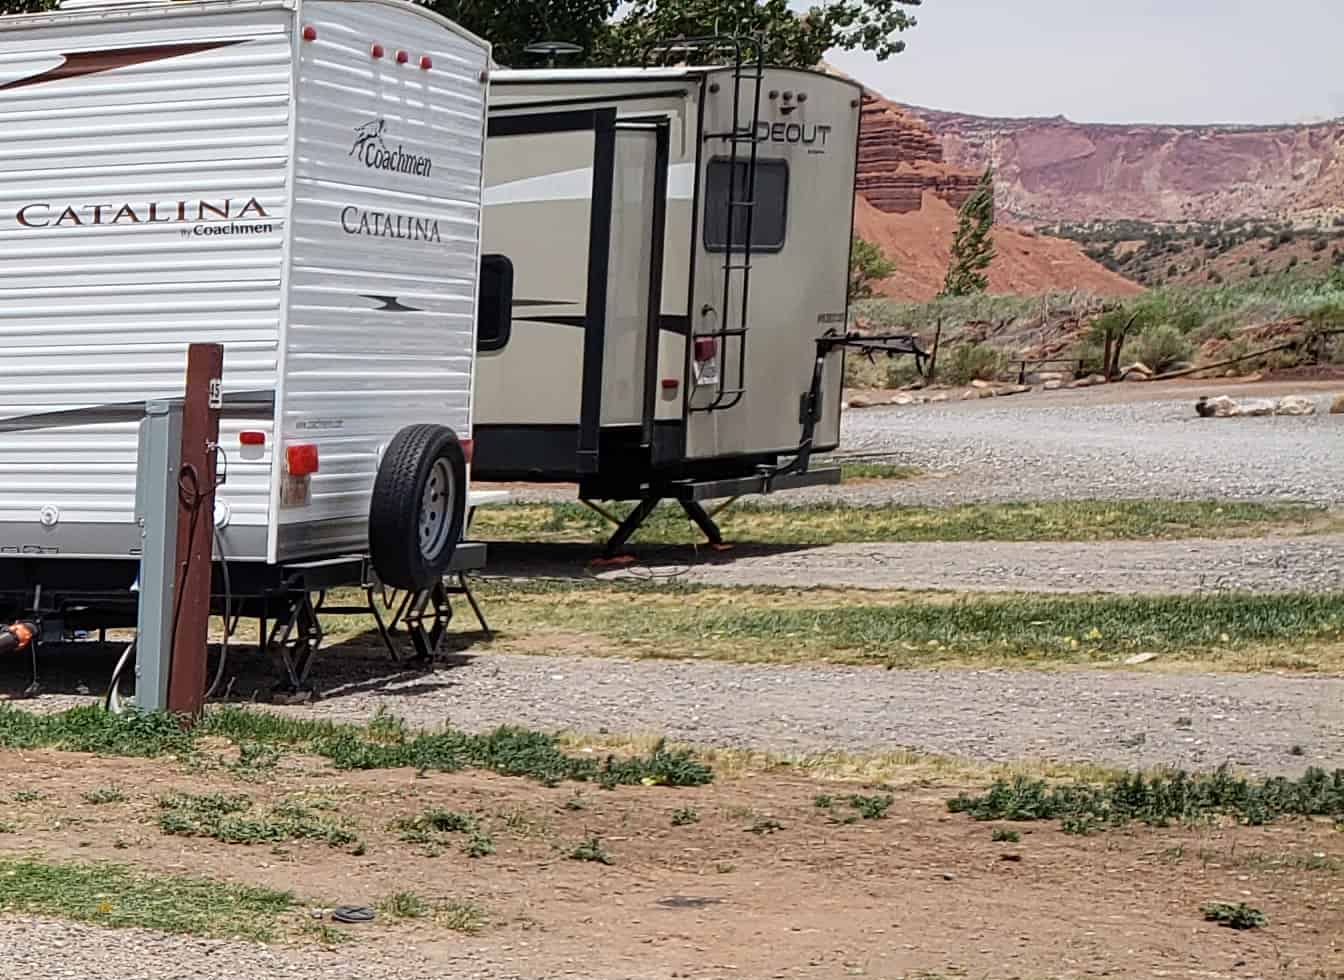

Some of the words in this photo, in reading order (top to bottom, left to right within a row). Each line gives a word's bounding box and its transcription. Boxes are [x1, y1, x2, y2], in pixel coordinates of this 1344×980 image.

[733, 120, 831, 144] HDEOUT
[365, 142, 432, 177] Coachmen
[15, 196, 271, 228] CATALINA
[341, 206, 441, 243] CATALINA
[193, 222, 273, 236] Coachmen
